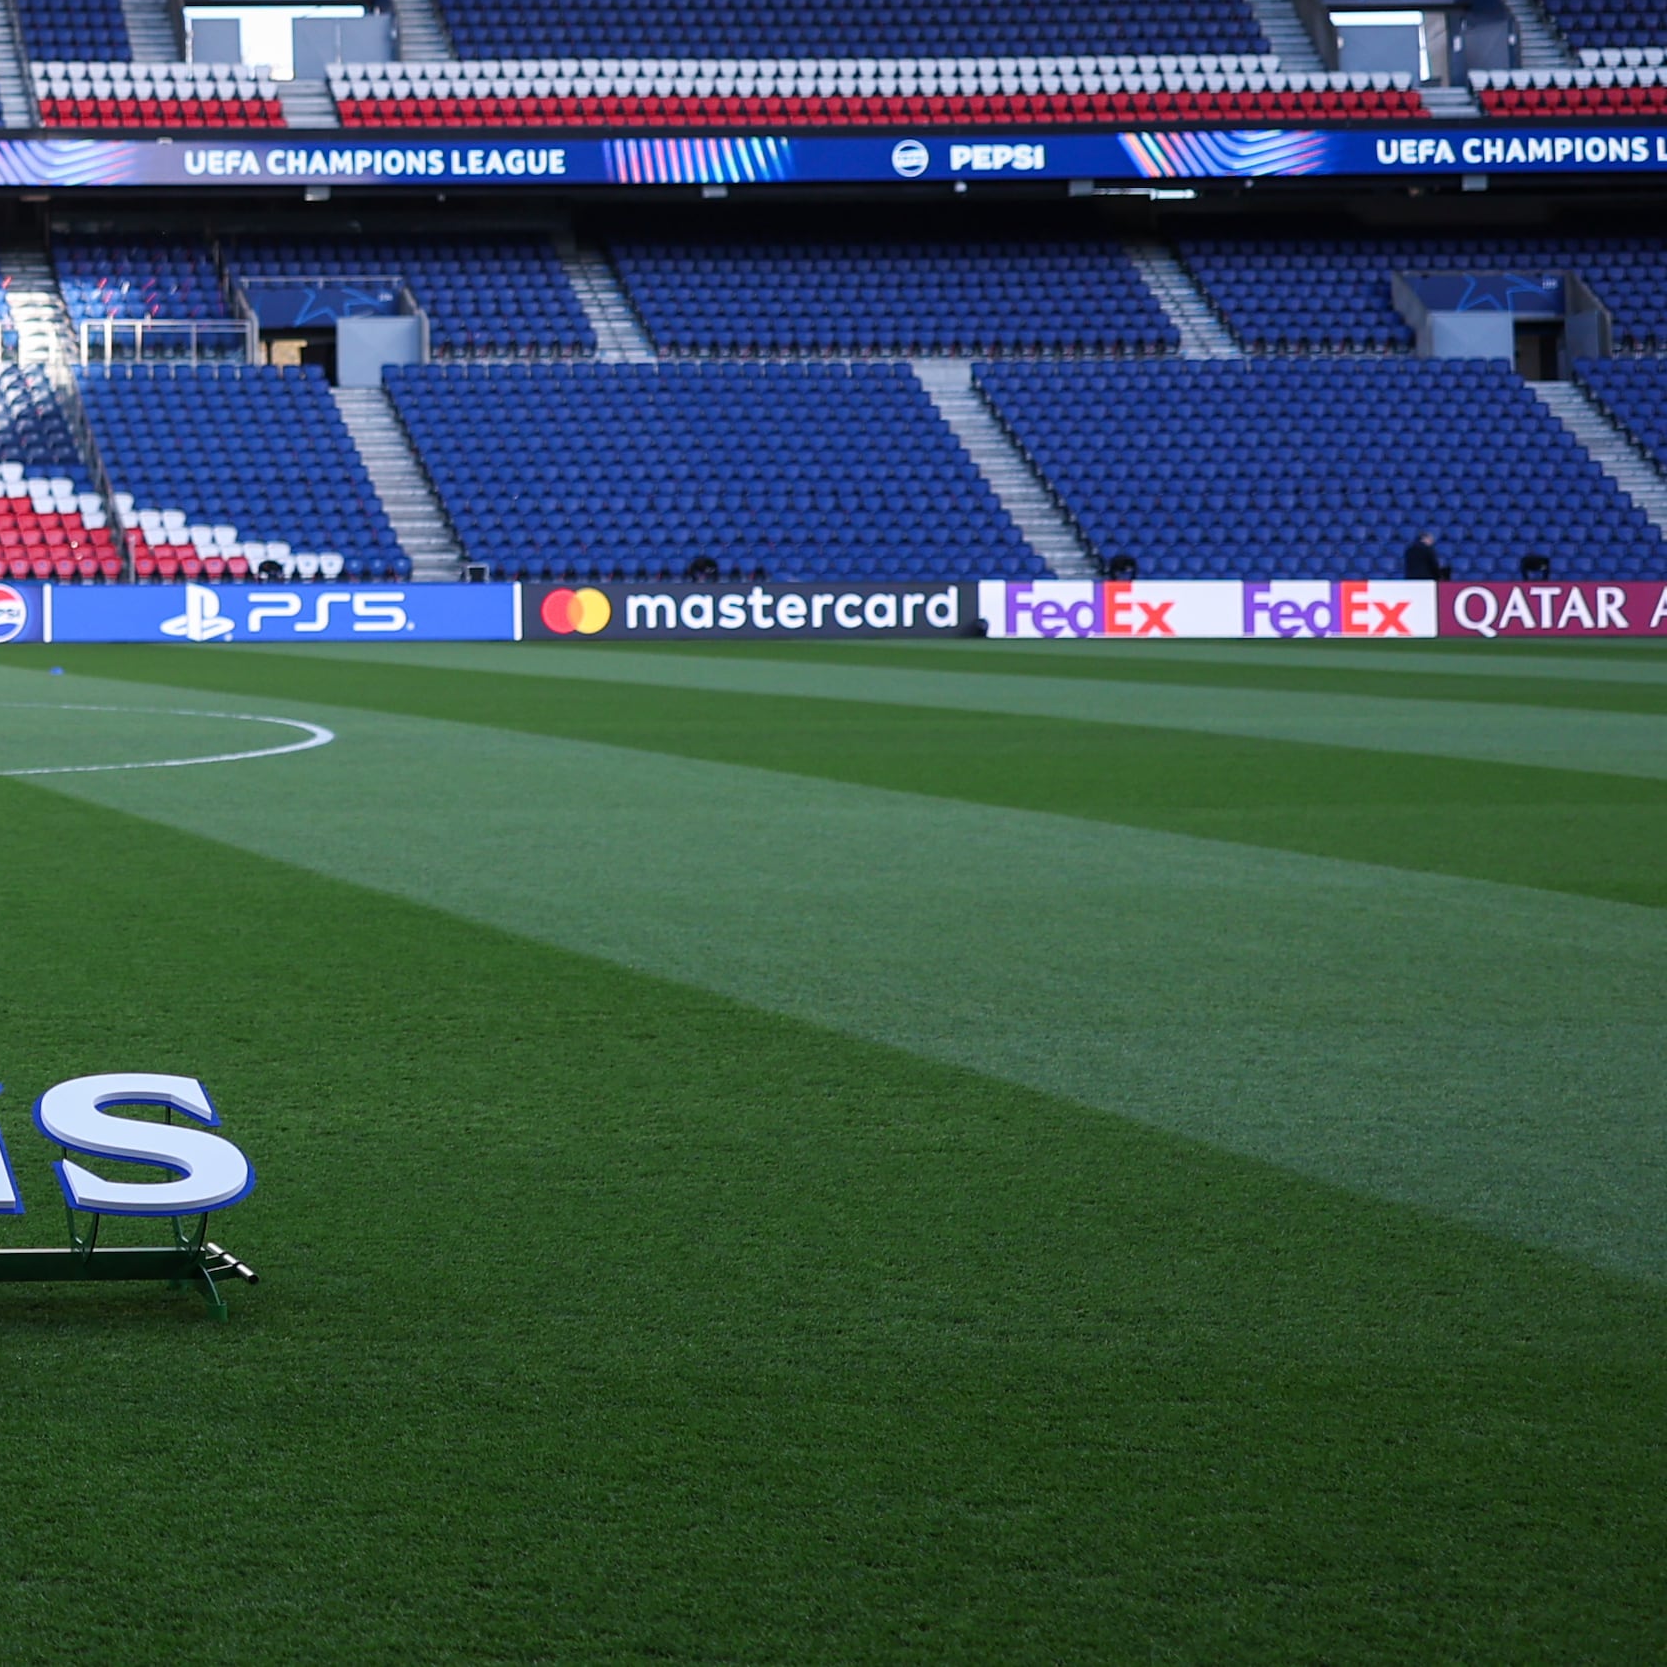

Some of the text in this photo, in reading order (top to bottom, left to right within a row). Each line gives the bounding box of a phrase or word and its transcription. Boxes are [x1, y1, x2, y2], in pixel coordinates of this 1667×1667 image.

[184, 149, 567, 176] UEFA CHAMPIONS LEAGUE
[950, 143, 1045, 171] PEPSI
[1376, 138, 1456, 165] UEFA
[1462, 136, 1649, 164] CHAMPIONS
[248, 591, 406, 632] PS5
[625, 585, 959, 630] mastercard
[1005, 580, 1176, 636] FedEx
[1243, 580, 1412, 636] FedEx
[1453, 585, 1629, 638] QATAR
